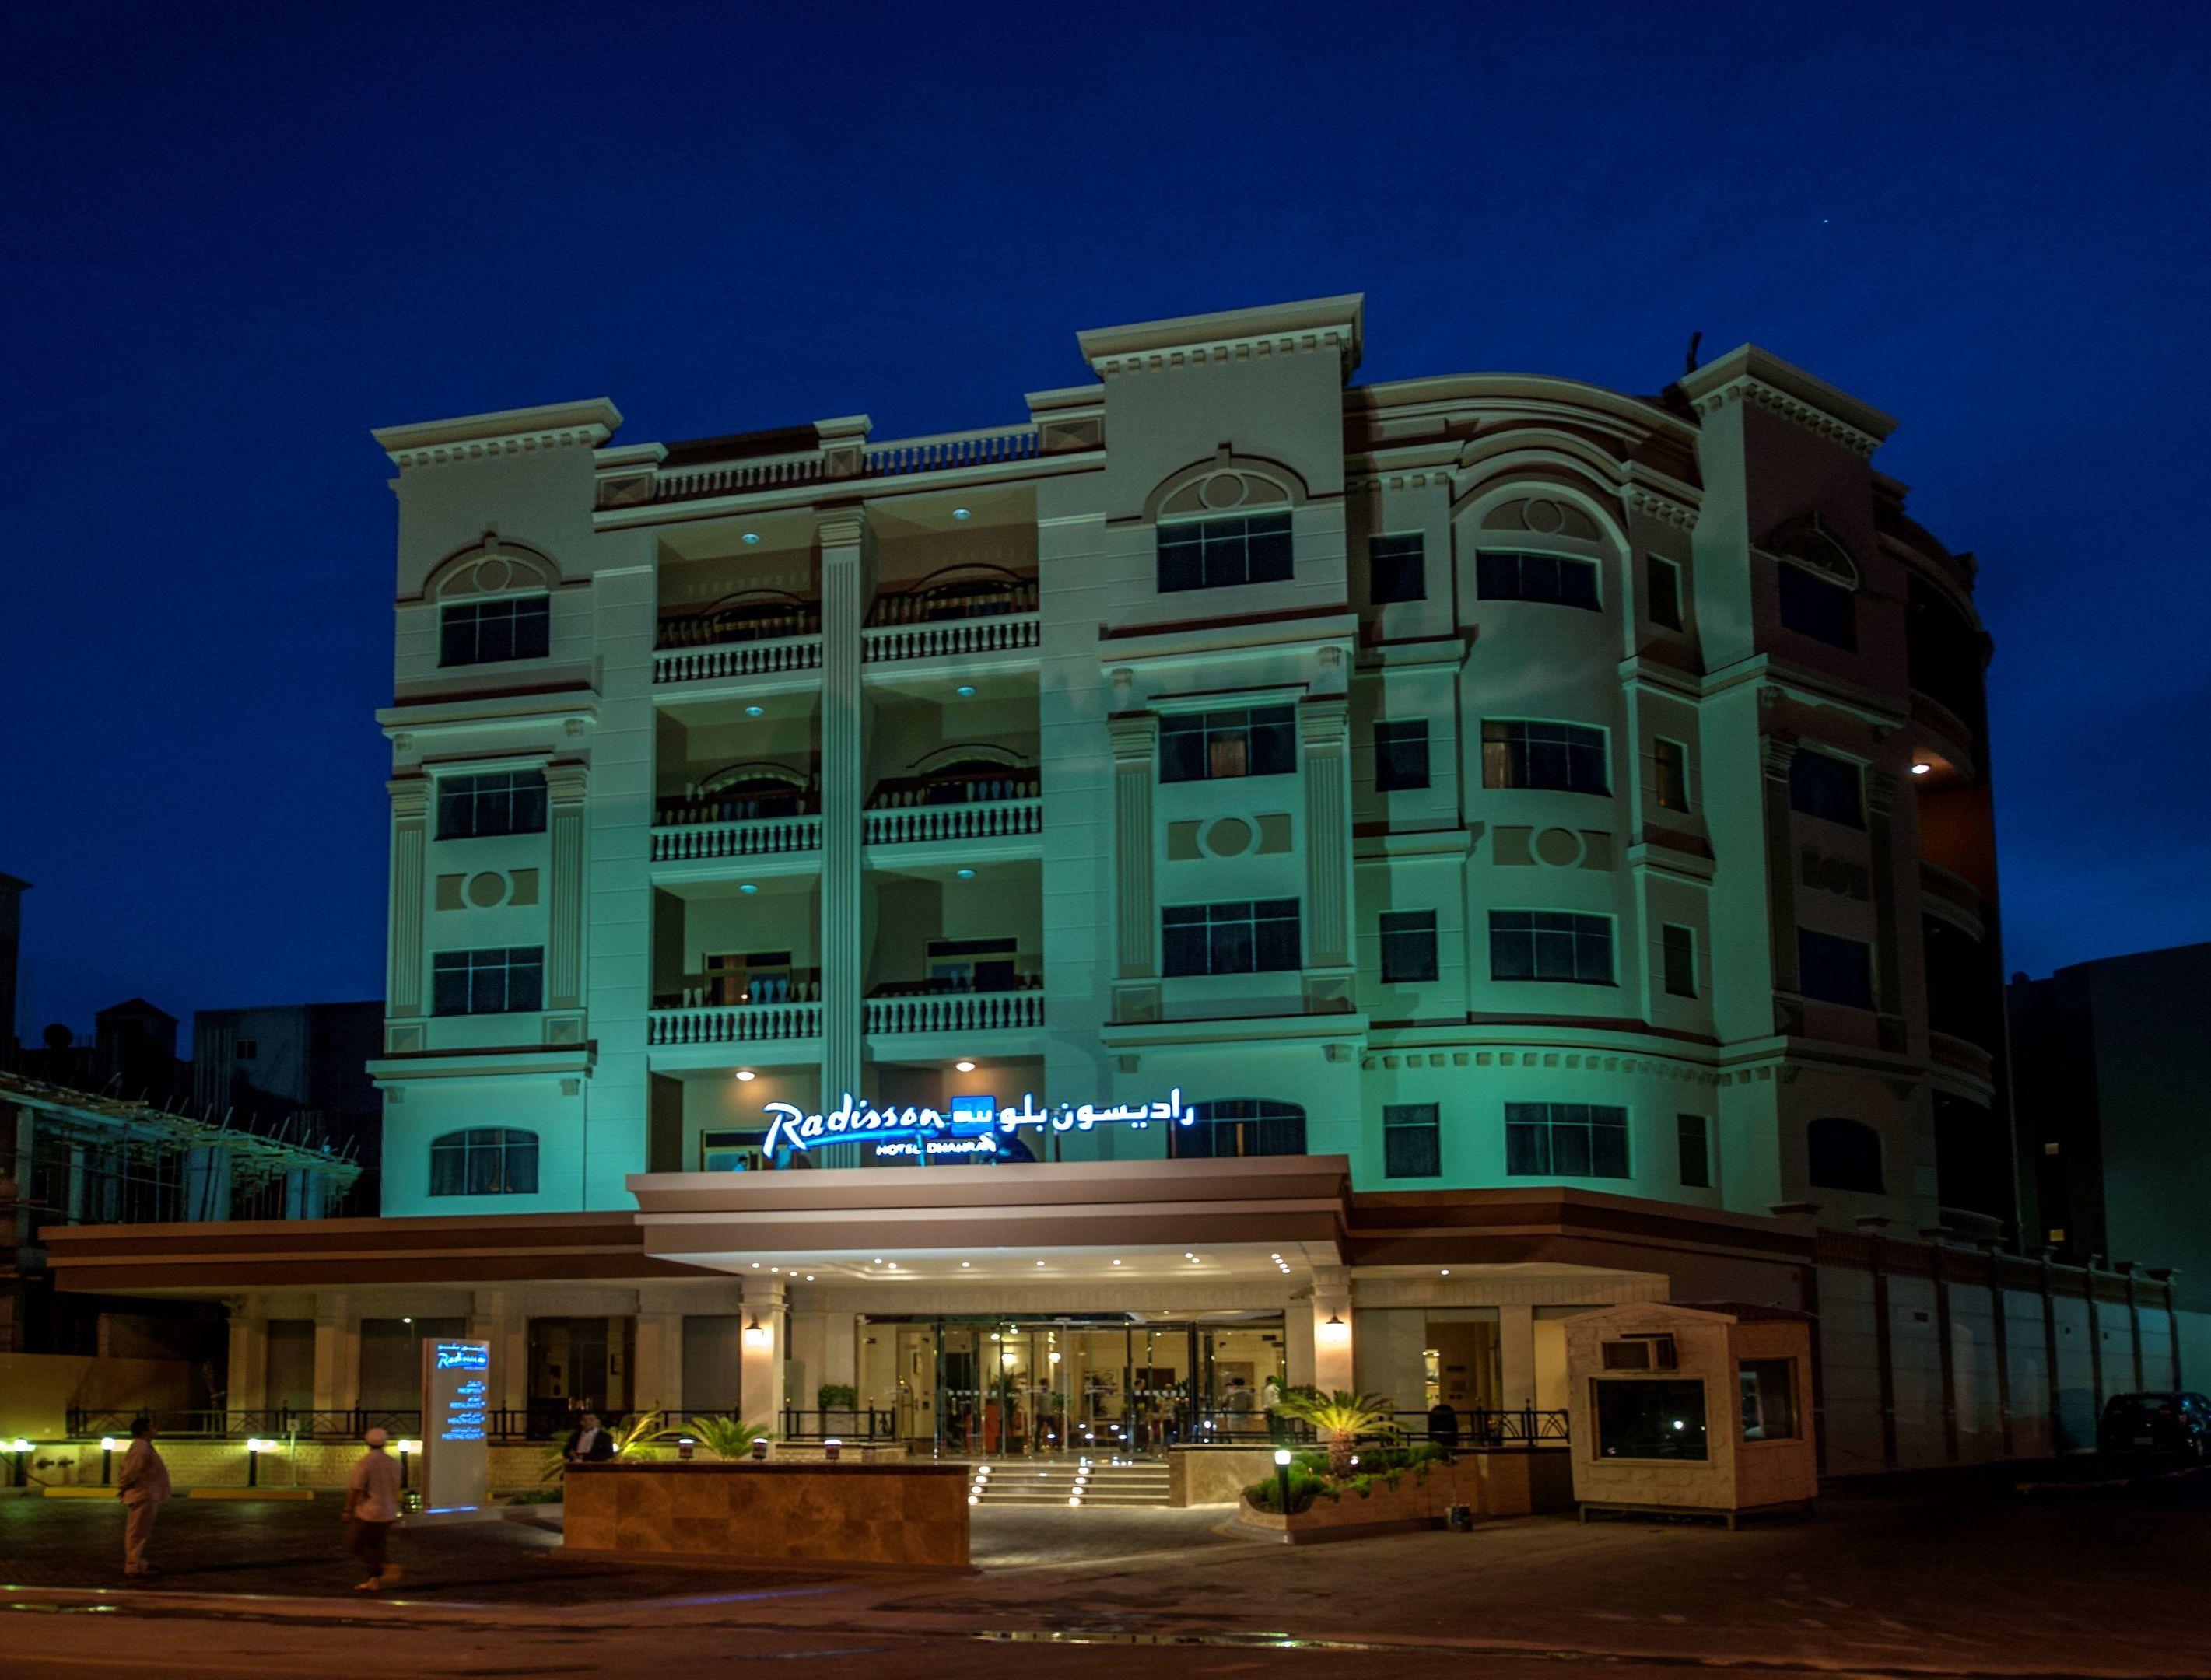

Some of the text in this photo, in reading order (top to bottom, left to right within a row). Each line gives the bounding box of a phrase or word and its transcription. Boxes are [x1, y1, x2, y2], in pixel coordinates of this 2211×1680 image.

[763, 1091, 944, 1158] Radisson
[1000, 1087, 1195, 1132] راديسون بلو
[875, 1144, 921, 1156] HOTEL
